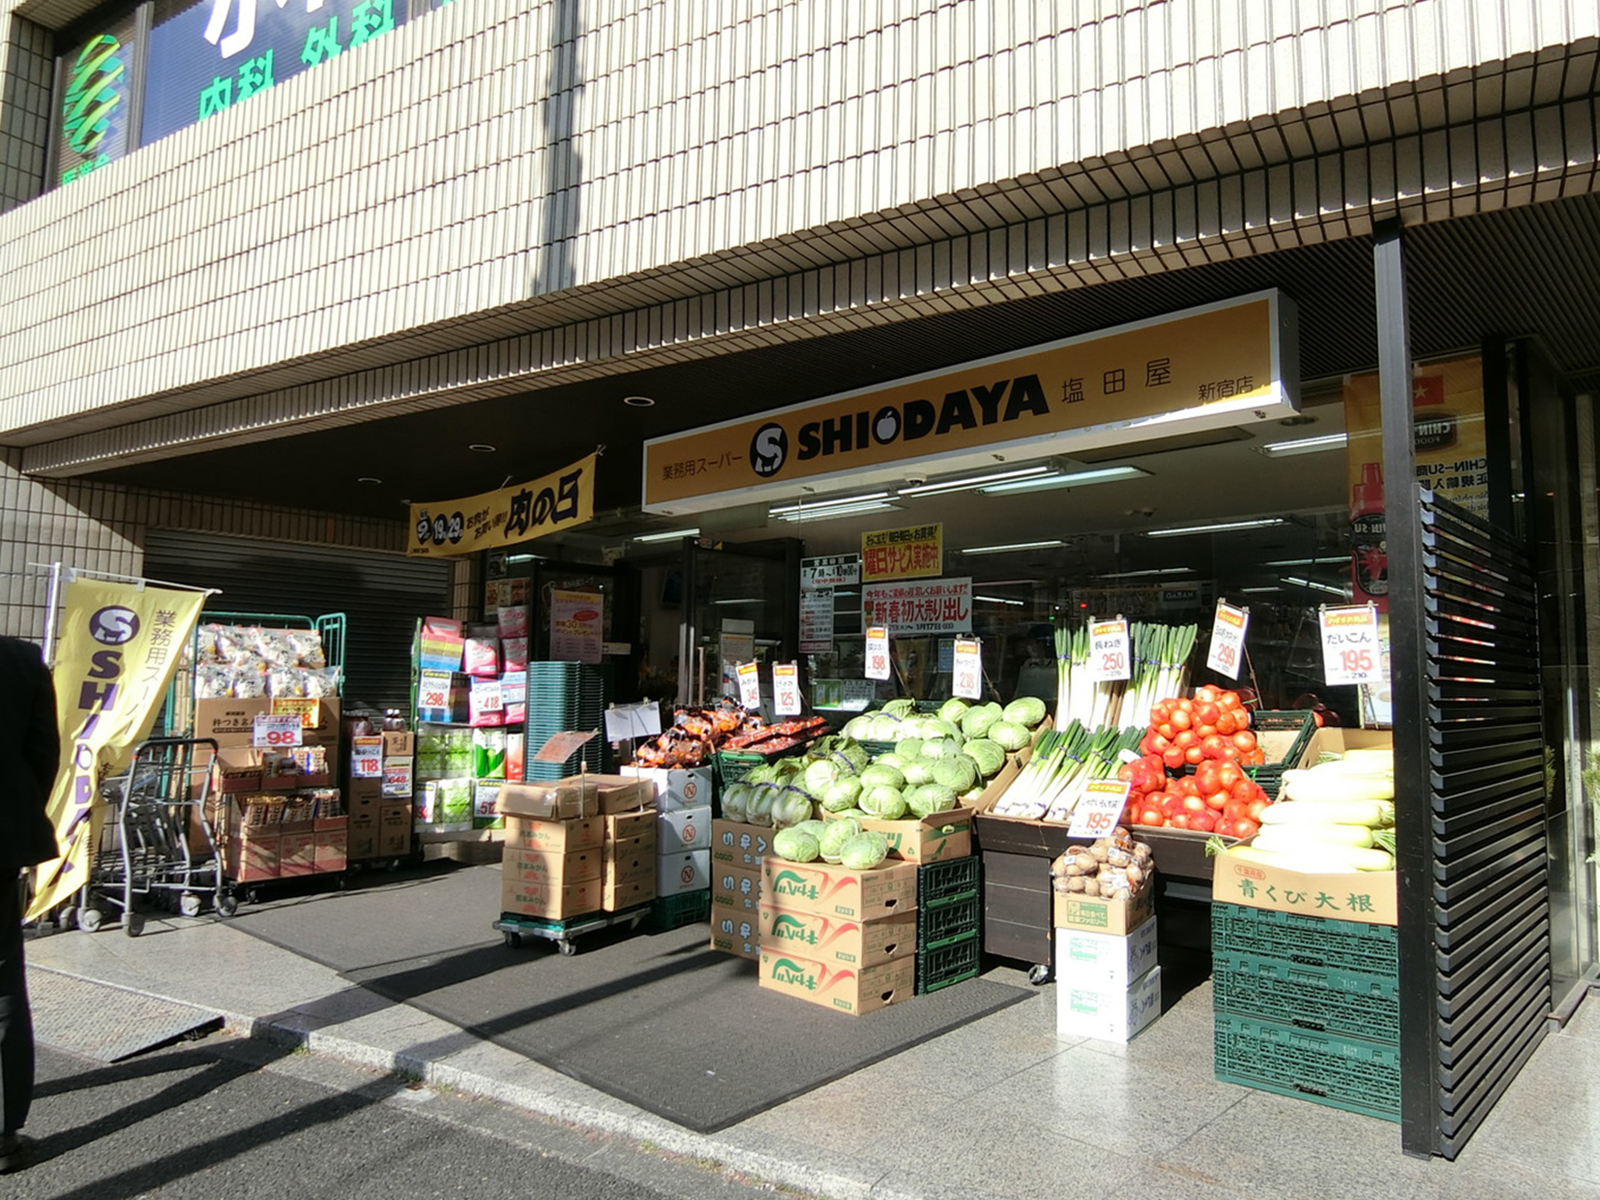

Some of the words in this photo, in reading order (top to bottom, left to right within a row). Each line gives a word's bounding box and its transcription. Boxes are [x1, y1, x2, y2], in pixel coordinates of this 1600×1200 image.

[199, 49, 274, 121] 内科
[1060, 357, 1172, 404] 塩田屋
[1198, 374, 1254, 402] 新宿店
[797, 374, 1050, 461] SHIODAYA
[661, 454, 743, 481] 業務用スーパー
[504, 468, 583, 539] 肉の日
[875, 596, 969, 624] 新春初大売り出し
[1095, 639, 1122, 650] 長ねぎ
[872, 655, 886, 671] 198
[1102, 652, 1124, 671] 250
[1217, 643, 1236, 668] 299
[1339, 649, 1373, 672] 195
[960, 672, 975, 689] 218
[425, 692, 445, 706] 298
[484, 695, 500, 709] 418
[780, 692, 794, 706] 125
[266, 730, 296, 745] 98
[361, 758, 379, 772] 118
[1086, 811, 1114, 829] 195
[1237, 877, 1376, 913] 青くび大根
